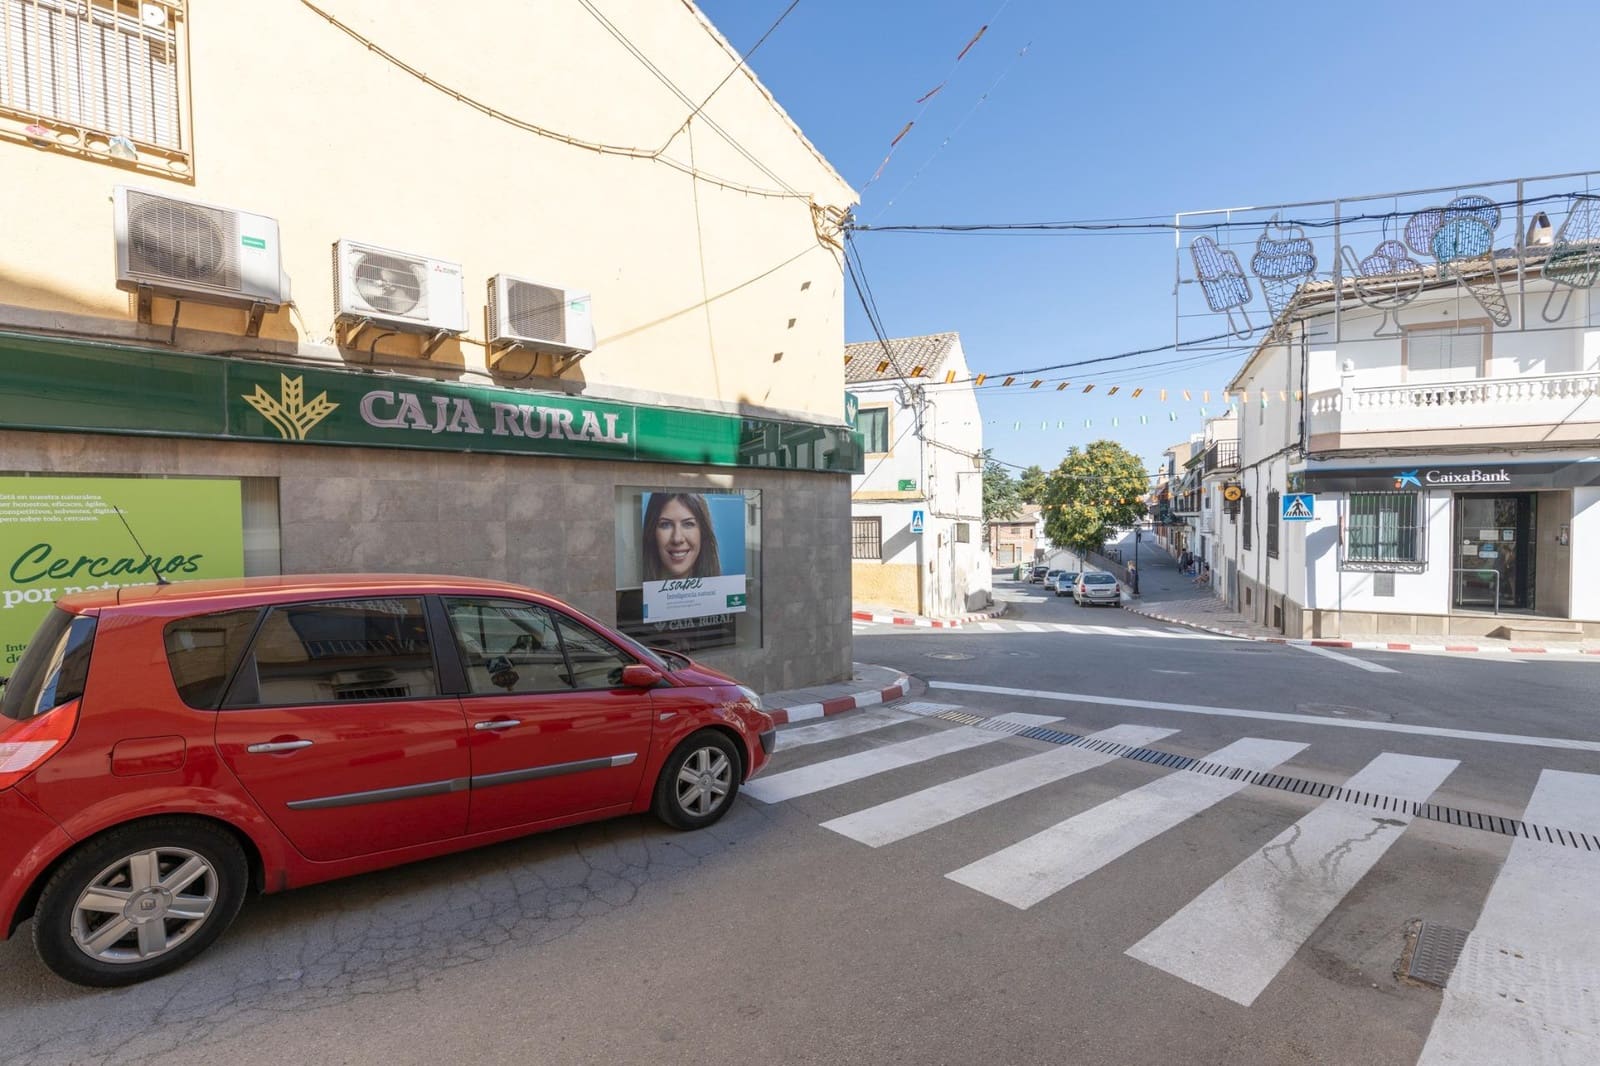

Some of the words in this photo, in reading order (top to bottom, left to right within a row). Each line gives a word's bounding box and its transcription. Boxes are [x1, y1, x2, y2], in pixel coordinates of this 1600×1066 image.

[359, 390, 485, 434] CAJA
[491, 401, 629, 444] RURAL
[1426, 469, 1511, 483] CaixaBank
[10, 543, 203, 584] Cercanos
[658, 577, 702, 592] Isabel
[3, 587, 57, 608] por
